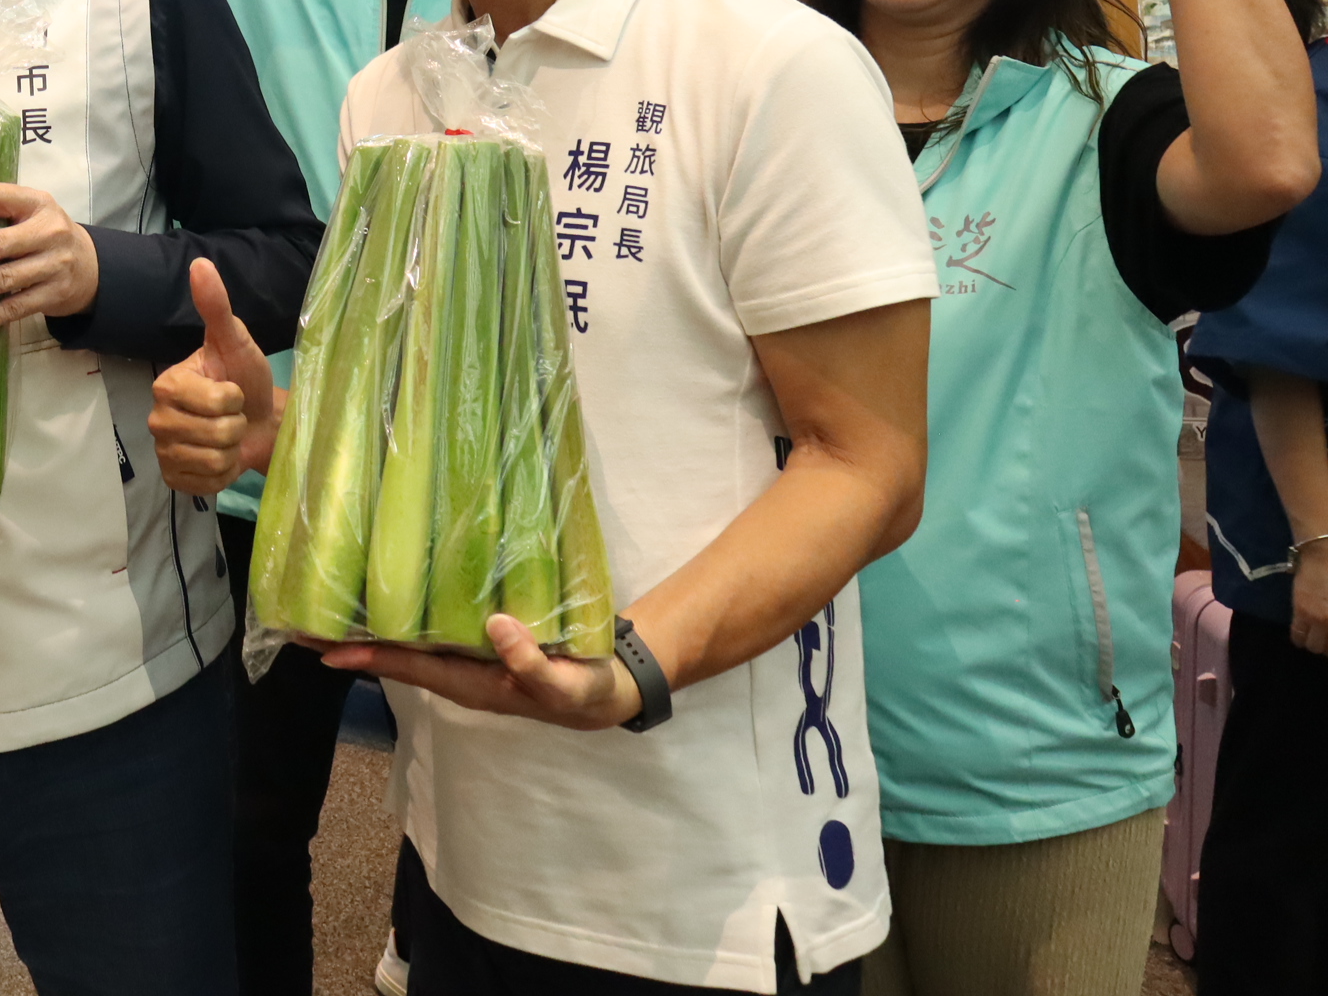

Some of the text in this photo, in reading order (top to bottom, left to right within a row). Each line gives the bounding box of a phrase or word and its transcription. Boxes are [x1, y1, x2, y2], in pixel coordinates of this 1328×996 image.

[554, 138, 612, 334] 楊宗民
[611, 100, 667, 263] 觀旅局長
